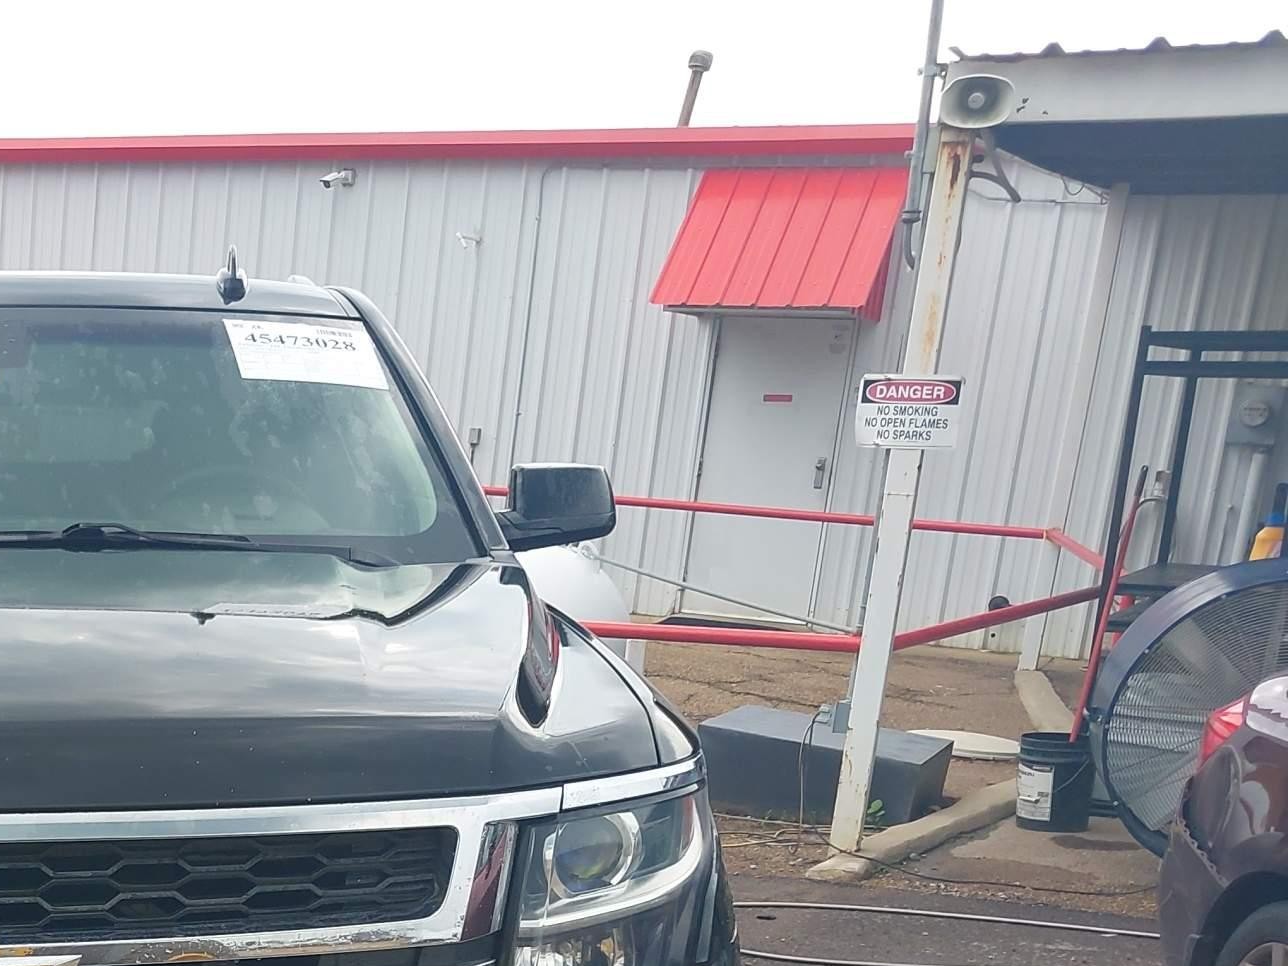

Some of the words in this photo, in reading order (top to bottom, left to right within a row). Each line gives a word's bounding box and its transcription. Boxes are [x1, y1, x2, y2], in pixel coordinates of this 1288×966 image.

[244, 332, 357, 351] 45473028
[876, 385, 945, 399] DANGER
[877, 406, 890, 416] NO
[893, 406, 938, 417] SMOKING
[864, 417, 877, 427] NO
[880, 418, 906, 428] OPEN
[908, 418, 949, 429] FLAMES
[877, 429, 890, 440] NO
[893, 430, 932, 441] SPARKS
